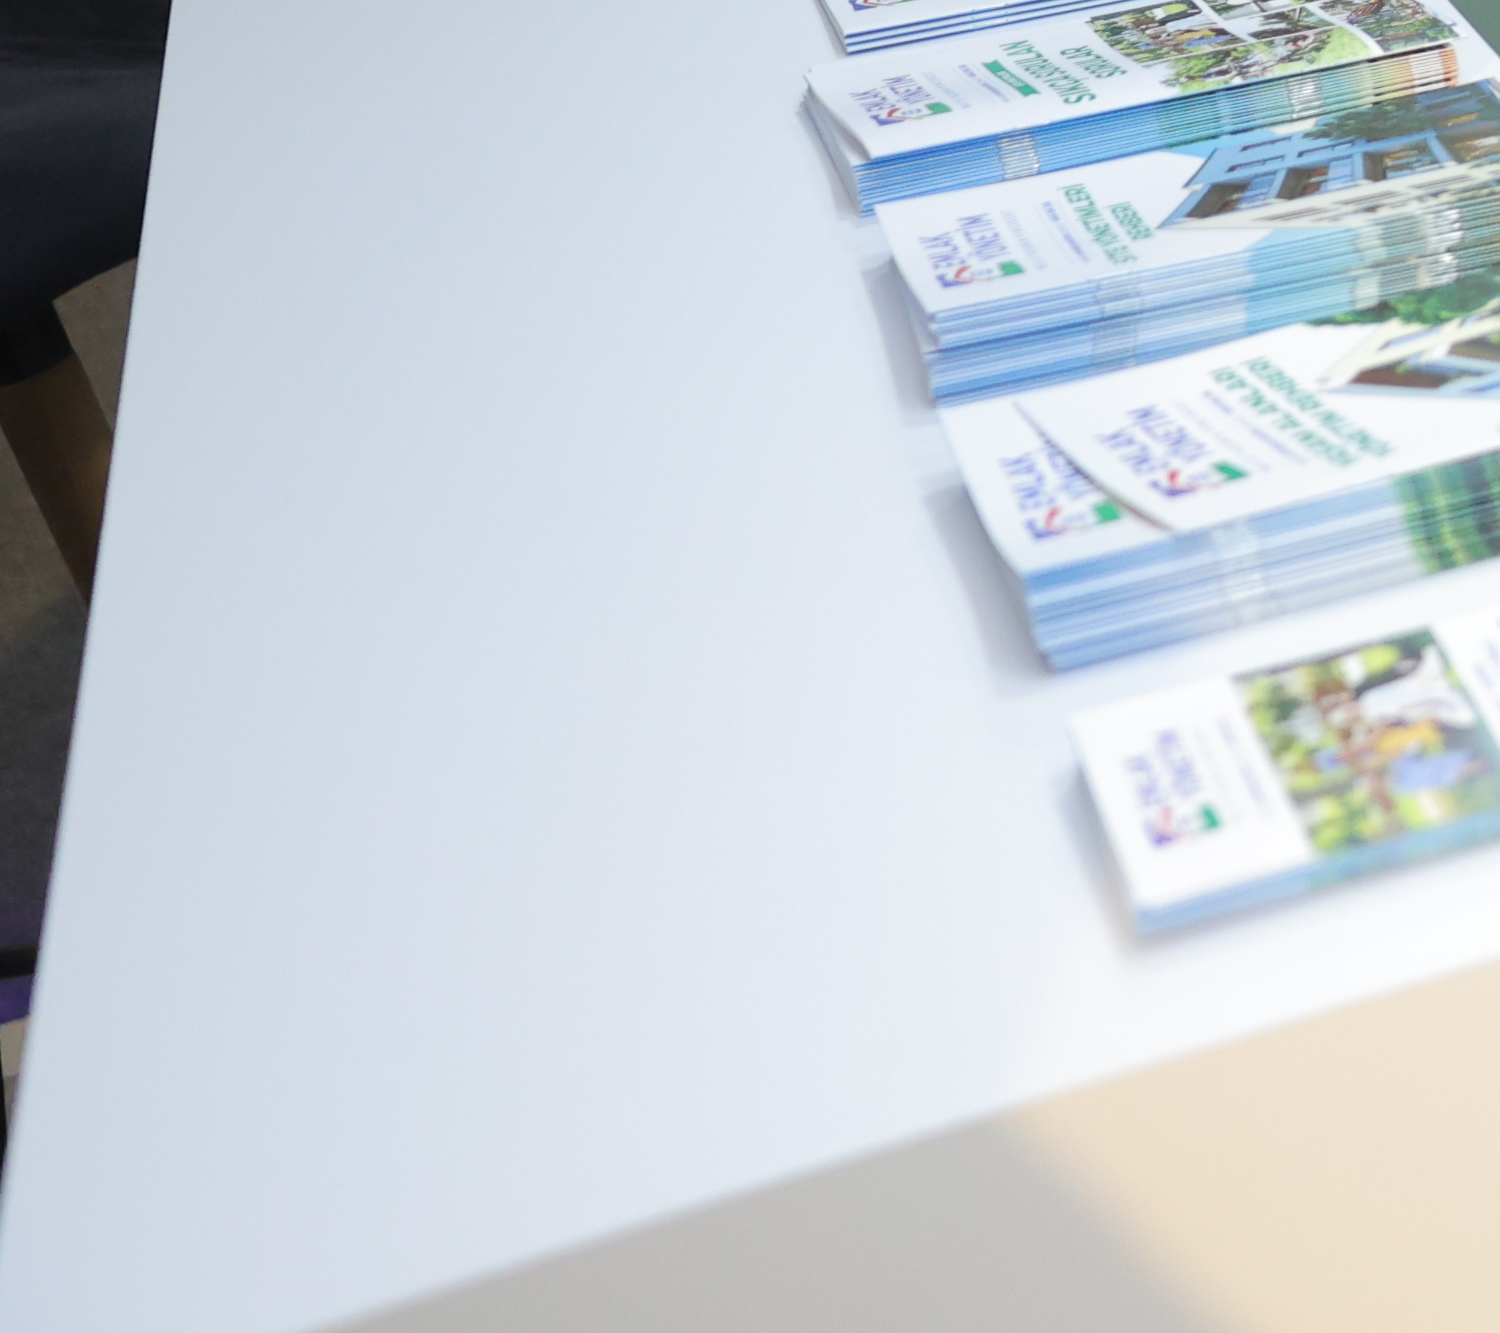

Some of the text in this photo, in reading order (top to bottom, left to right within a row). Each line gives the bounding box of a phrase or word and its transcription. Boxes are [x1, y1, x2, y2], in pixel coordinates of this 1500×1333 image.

[999, 39, 1067, 77] SORULAN
[1060, 45, 1127, 78] SORULAR
[849, 88, 897, 113] EMLAK
[881, 74, 935, 106] YÖNETİM
[1043, 73, 1097, 104] SIKÇA
[1057, 183, 1125, 249] YÖNETİMLERİ
[1102, 201, 1155, 241] REHBERİ
[918, 230, 968, 270] EMLAK
[956, 212, 1012, 262] YÖNETİM
